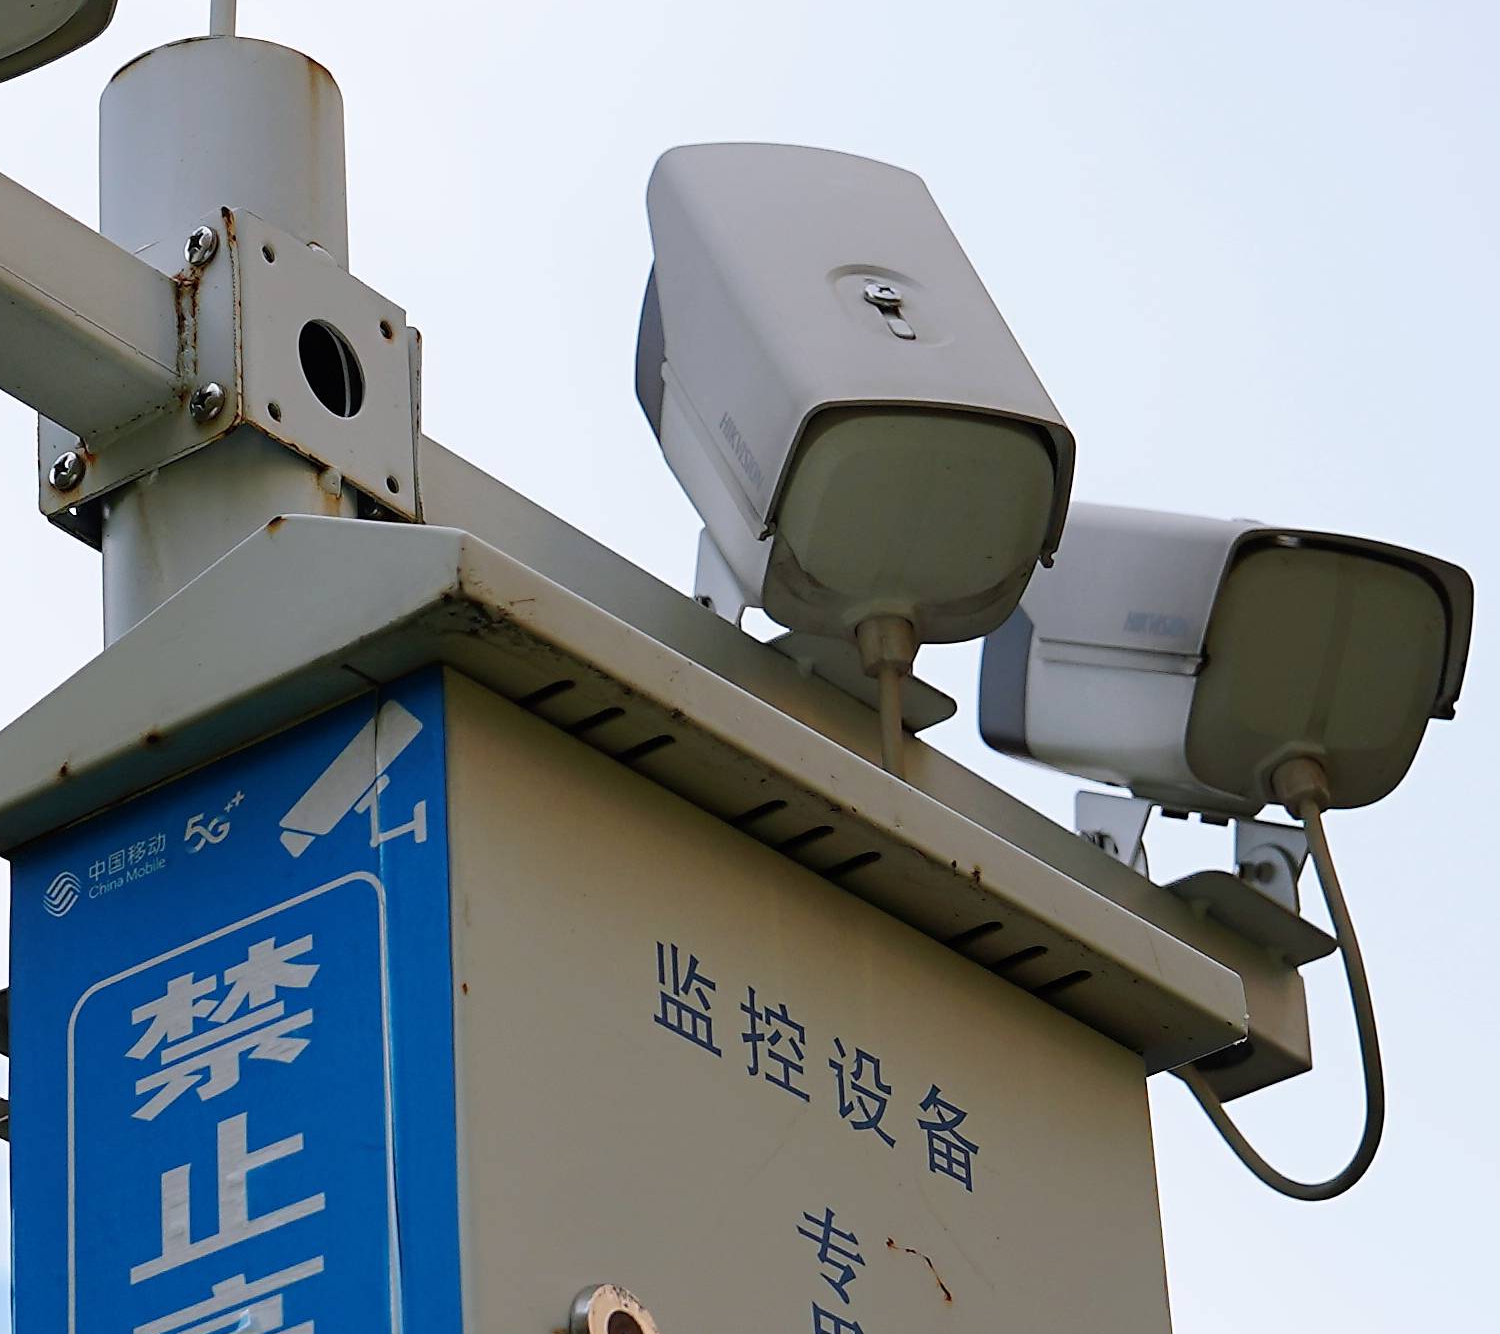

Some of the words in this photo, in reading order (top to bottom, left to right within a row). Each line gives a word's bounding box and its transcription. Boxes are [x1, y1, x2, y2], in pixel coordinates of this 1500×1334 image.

[88, 832, 166, 882] 中国移动
[88, 875, 124, 899] China
[126, 857, 166, 883] Mobile
[654, 941, 980, 1193] 监控设备
